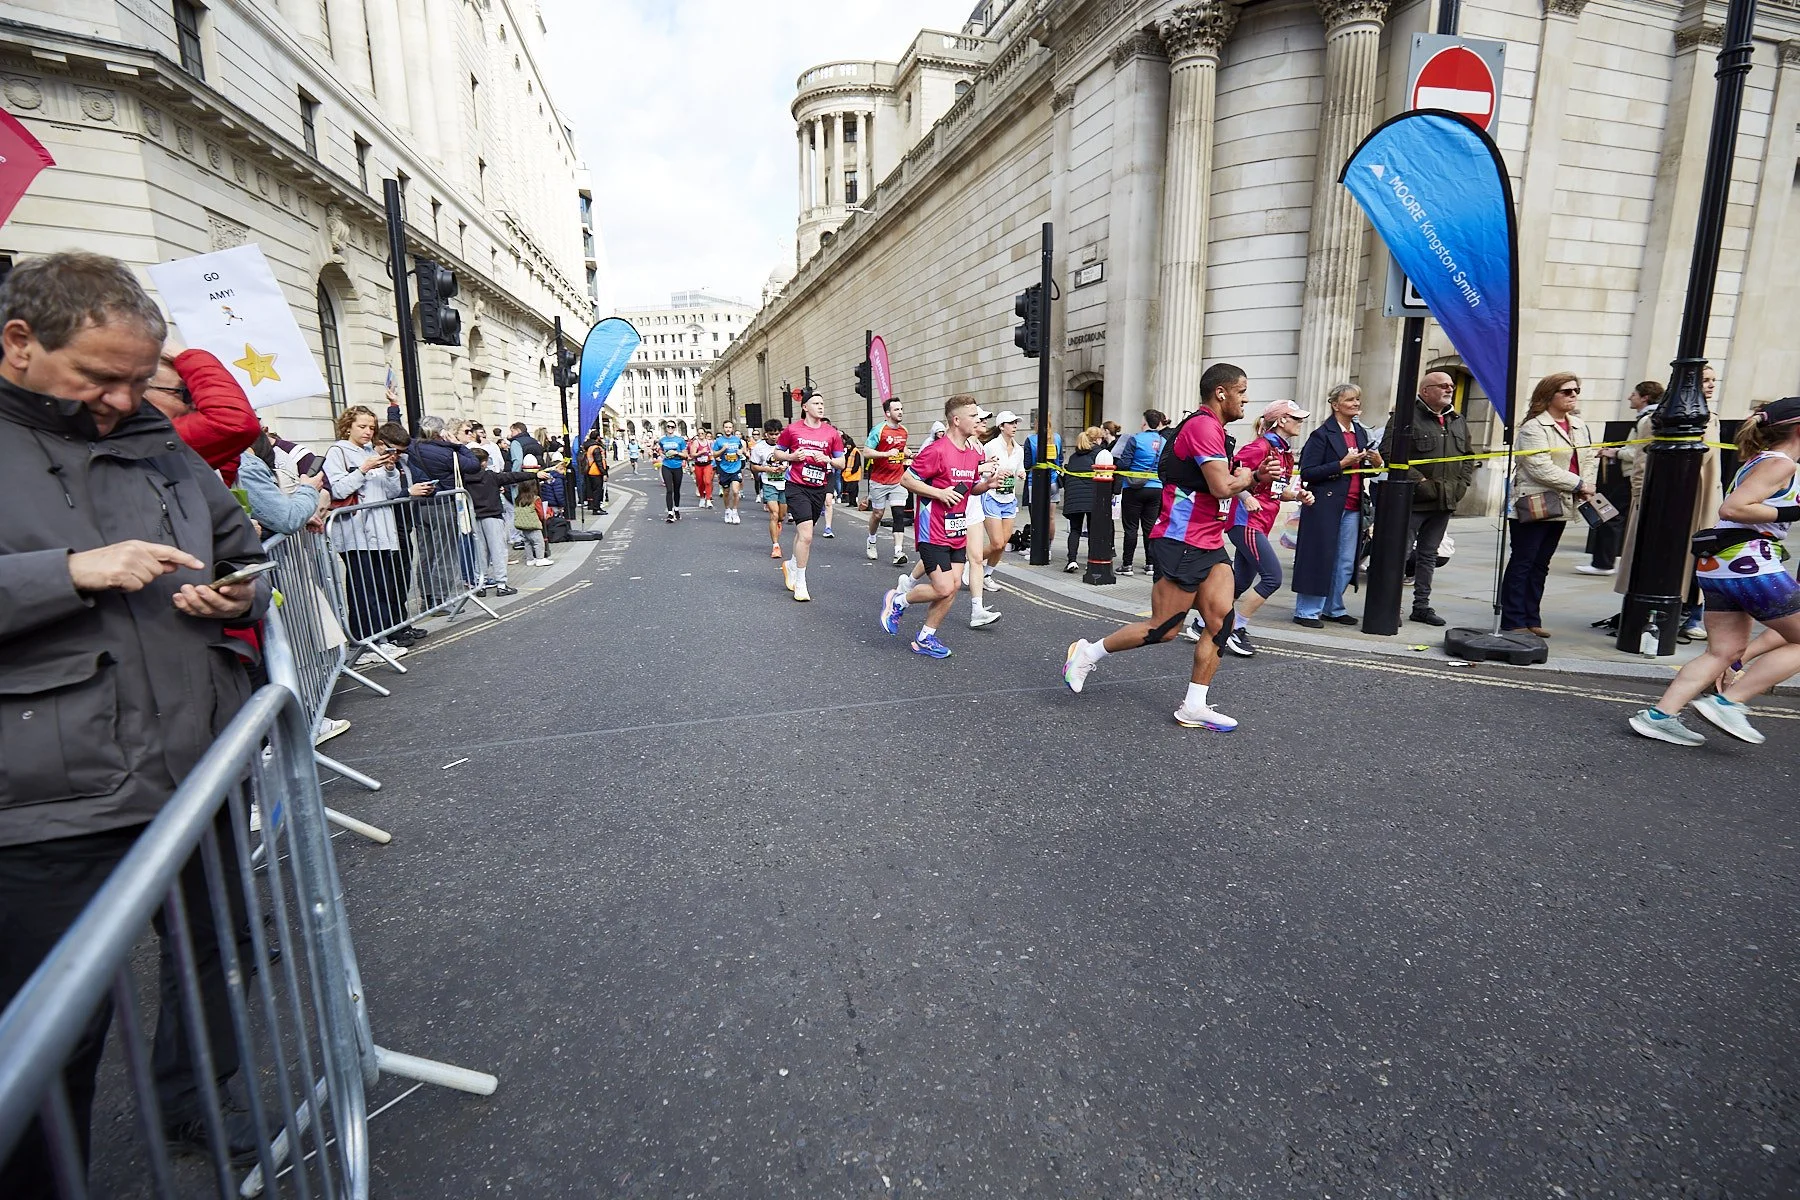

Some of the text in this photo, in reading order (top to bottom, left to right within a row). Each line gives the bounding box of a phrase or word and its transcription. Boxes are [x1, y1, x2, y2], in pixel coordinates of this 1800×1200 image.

[1389, 175, 1481, 308] MOORE Kingston Smith
[203, 272, 219, 282] GO
[209, 288, 235, 301] AMY!
[797, 437, 829, 449] Tommy's
